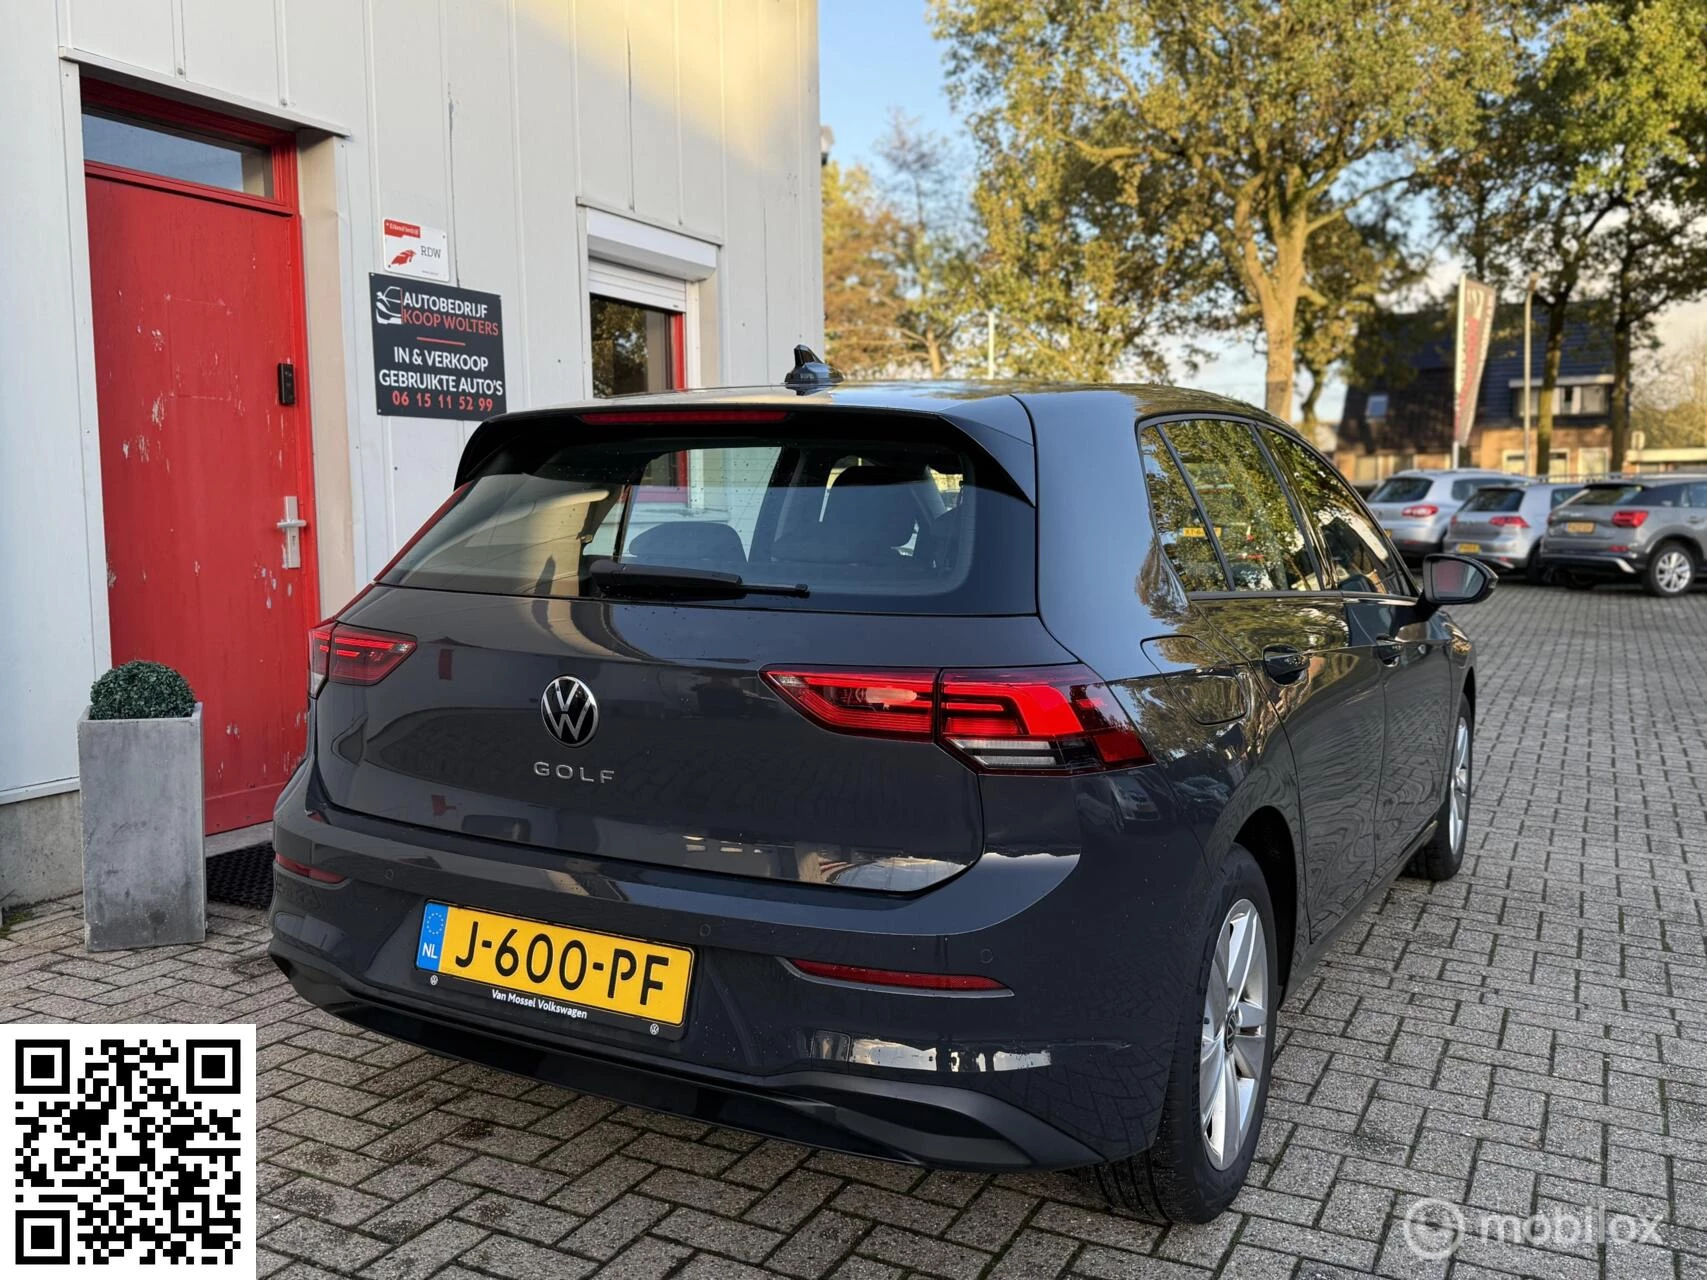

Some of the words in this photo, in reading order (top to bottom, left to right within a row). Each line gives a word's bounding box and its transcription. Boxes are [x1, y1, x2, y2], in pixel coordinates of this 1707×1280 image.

[420, 245, 441, 259] RDW
[403, 292, 488, 318] AUTOBEDRIJF
[403, 309, 441, 327] KOOP
[444, 316, 499, 336] WOLTERS
[394, 346, 409, 364] IN
[412, 349, 423, 365] &
[424, 350, 489, 372] VERKOOP
[379, 369, 457, 391] GEBRUIKTE
[459, 377, 503, 395] AUTO'S
[392, 391, 409, 406] 06
[416, 392, 431, 407] 15
[438, 394, 452, 409] 11
[459, 396, 474, 411] 52
[479, 397, 493, 412] 99
[541, 676, 598, 747] VW
[533, 761, 615, 783] GOLF
[422, 943, 438, 959] NL
[455, 921, 669, 1005] J-600-PF
[492, 988, 506, 1001] Van
[507, 991, 536, 1008] Mossel
[537, 999, 588, 1019] Volkswagen
